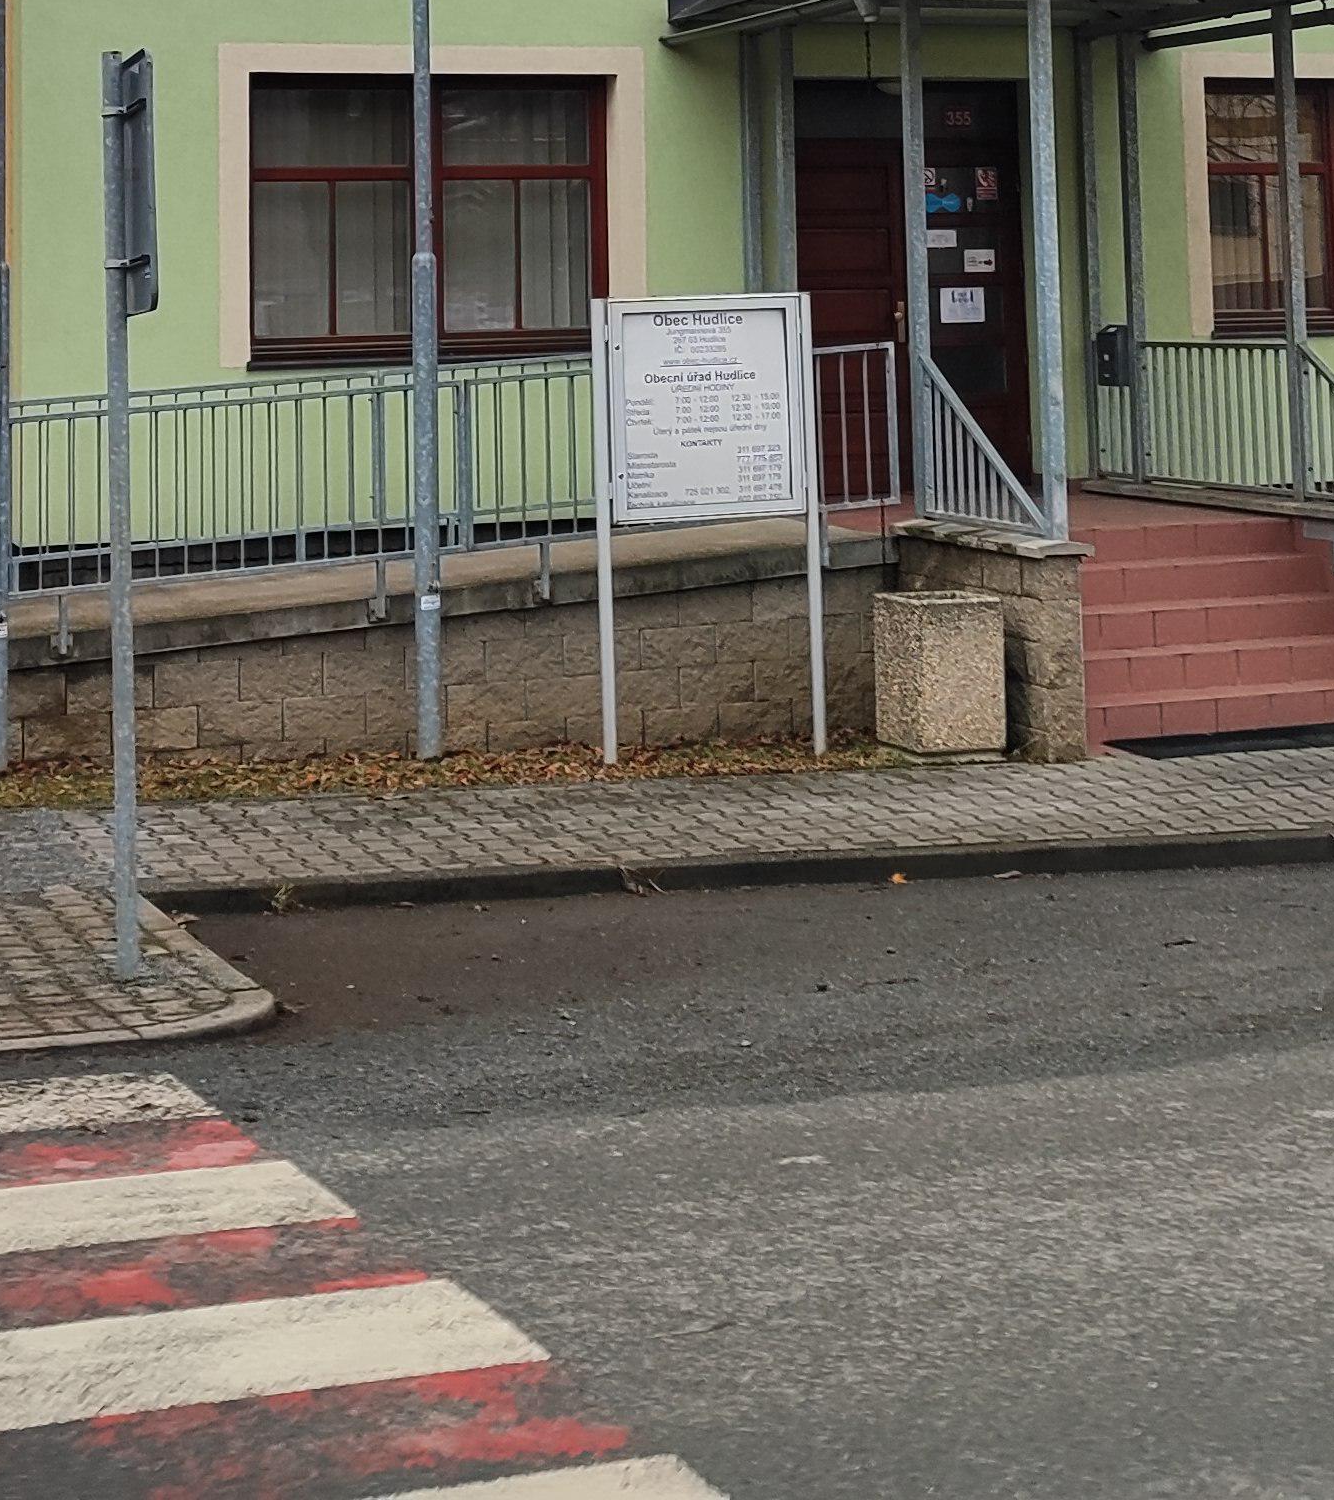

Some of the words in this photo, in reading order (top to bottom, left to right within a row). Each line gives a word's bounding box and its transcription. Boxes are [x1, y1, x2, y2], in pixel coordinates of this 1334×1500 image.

[946, 111, 971, 126] 355
[653, 314, 688, 327] Obec
[693, 313, 743, 326] Hudlice
[644, 372, 683, 384] Obecní
[687, 371, 712, 382] úřad
[715, 370, 756, 381] Hudlice
[681, 439, 723, 447] KONTAKTY
